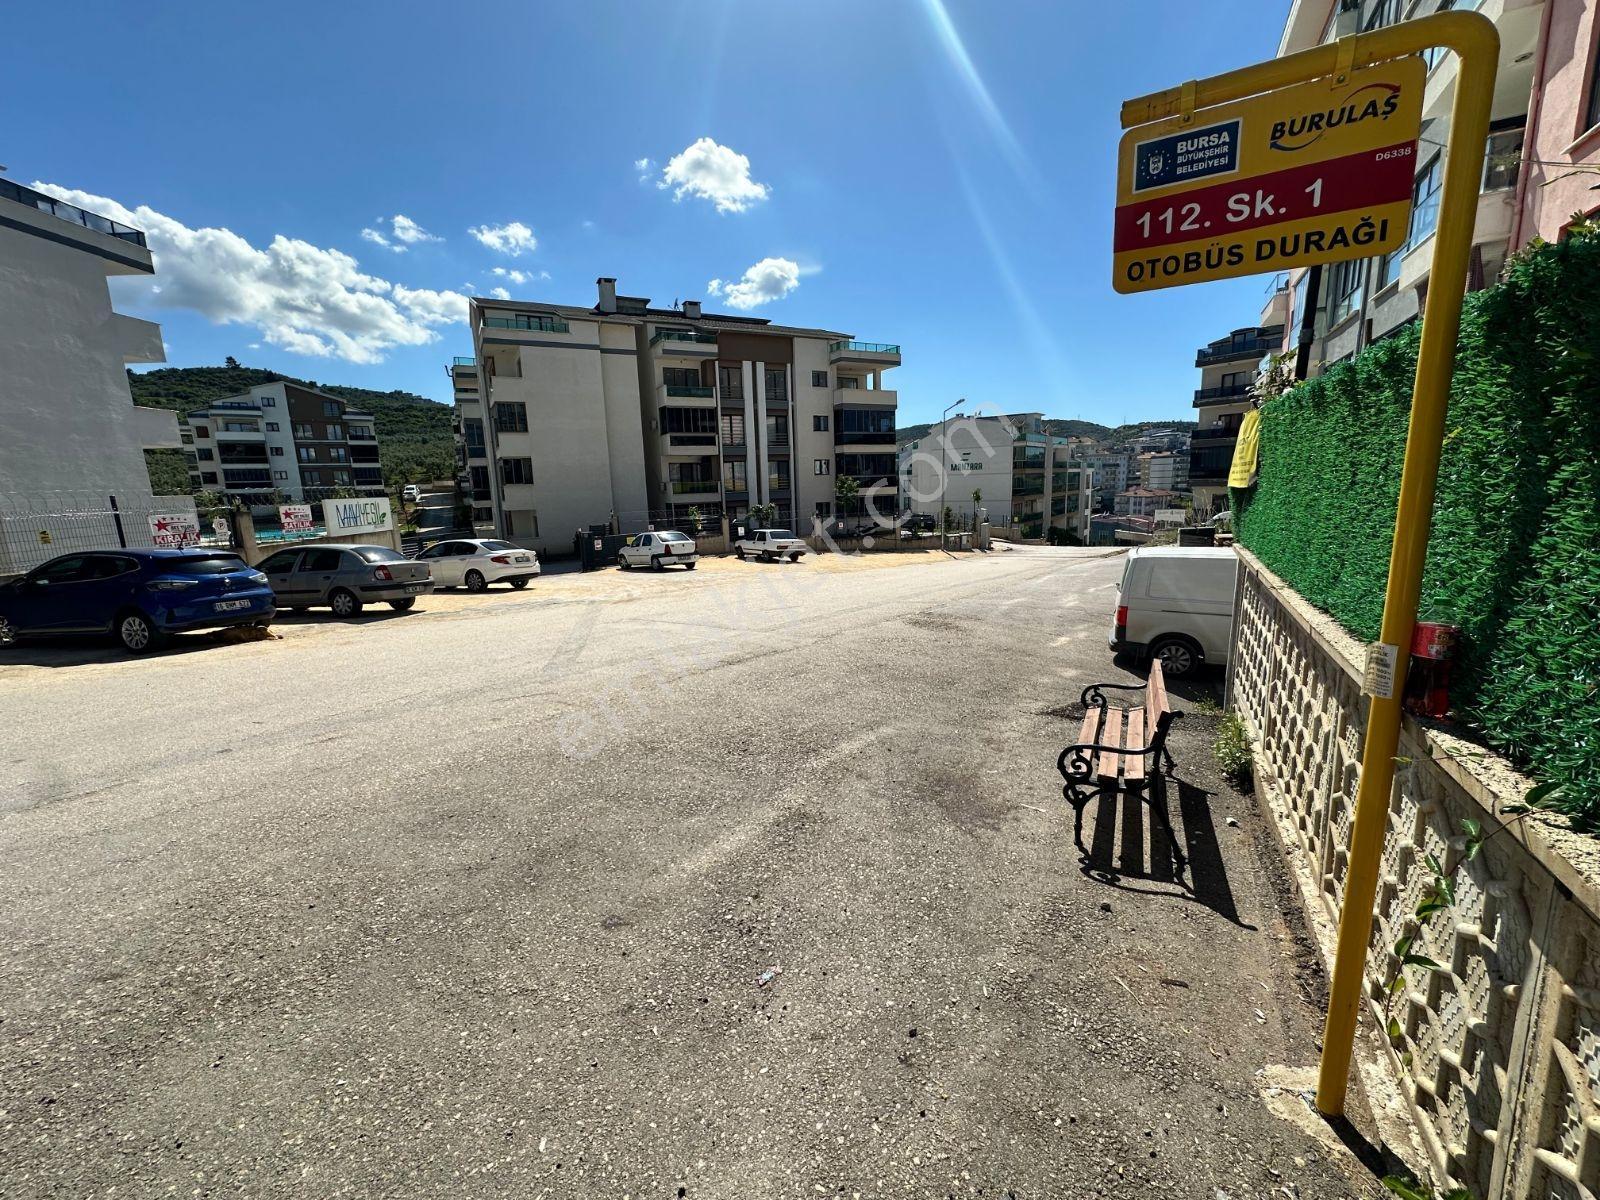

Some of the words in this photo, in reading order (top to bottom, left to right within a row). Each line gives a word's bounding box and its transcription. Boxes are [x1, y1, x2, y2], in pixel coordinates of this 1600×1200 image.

[1270, 93, 1400, 142] BURULAŞ
[1176, 130, 1230, 153] BURSA
[1176, 144, 1229, 164] BÜYÜKŞEHİR
[1176, 155, 1229, 175] BELEDİYESİ
[1375, 147, 1411, 161] D6338
[1136, 202, 1211, 238] 112.
[1226, 189, 1287, 222] Sk.
[1305, 178, 1322, 207] 1
[1127, 242, 1244, 282] OTOBÜS
[1255, 216, 1388, 261] DURAĞI
